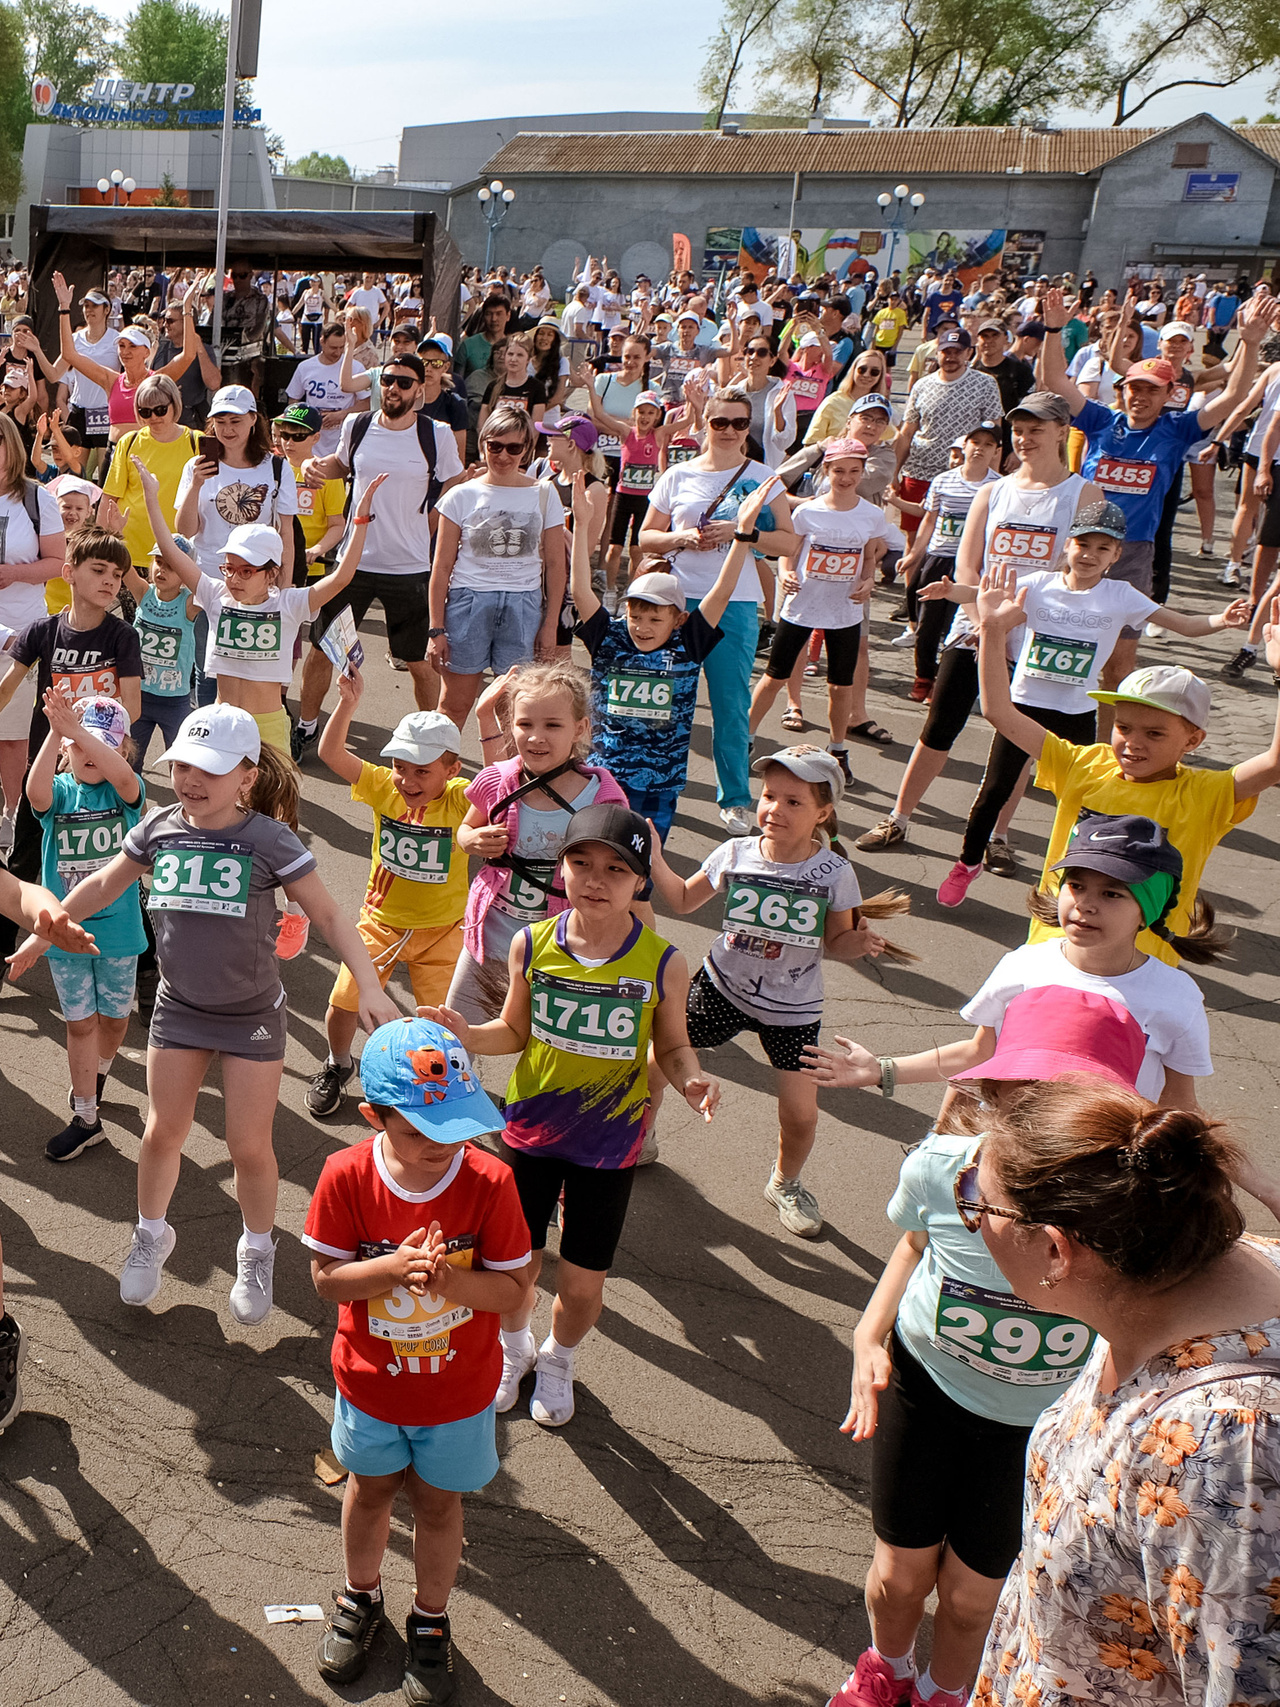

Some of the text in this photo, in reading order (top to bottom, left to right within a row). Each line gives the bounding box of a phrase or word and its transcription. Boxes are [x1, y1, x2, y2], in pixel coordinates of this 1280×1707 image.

[91, 78, 196, 105] ЦЕНТР
[670, 359, 696, 370] 421
[308, 380, 326, 399] 25
[792, 379, 819, 394] 496
[598, 434, 621, 447] 89
[669, 449, 698, 462] 137
[623, 468, 654, 483] 144
[1096, 463, 1153, 485] 1453
[993, 532, 1051, 555] 655
[811, 552, 857, 574] 792
[1035, 606, 1113, 630] adidas
[220, 618, 279, 649] 138
[53, 648, 103, 665] DO IT
[1027, 644, 1094, 673] 1767
[608, 677, 671, 705] 1746
[187, 727, 210, 739] GAP
[57, 821, 123, 855] 1701
[380, 828, 444, 871] 261
[153, 853, 243, 898] 313
[728, 887, 820, 933] 263
[532, 992, 635, 1039] 1716
[399, 1336, 449, 1353] POP CORN
[939, 1306, 1090, 1366] 299
